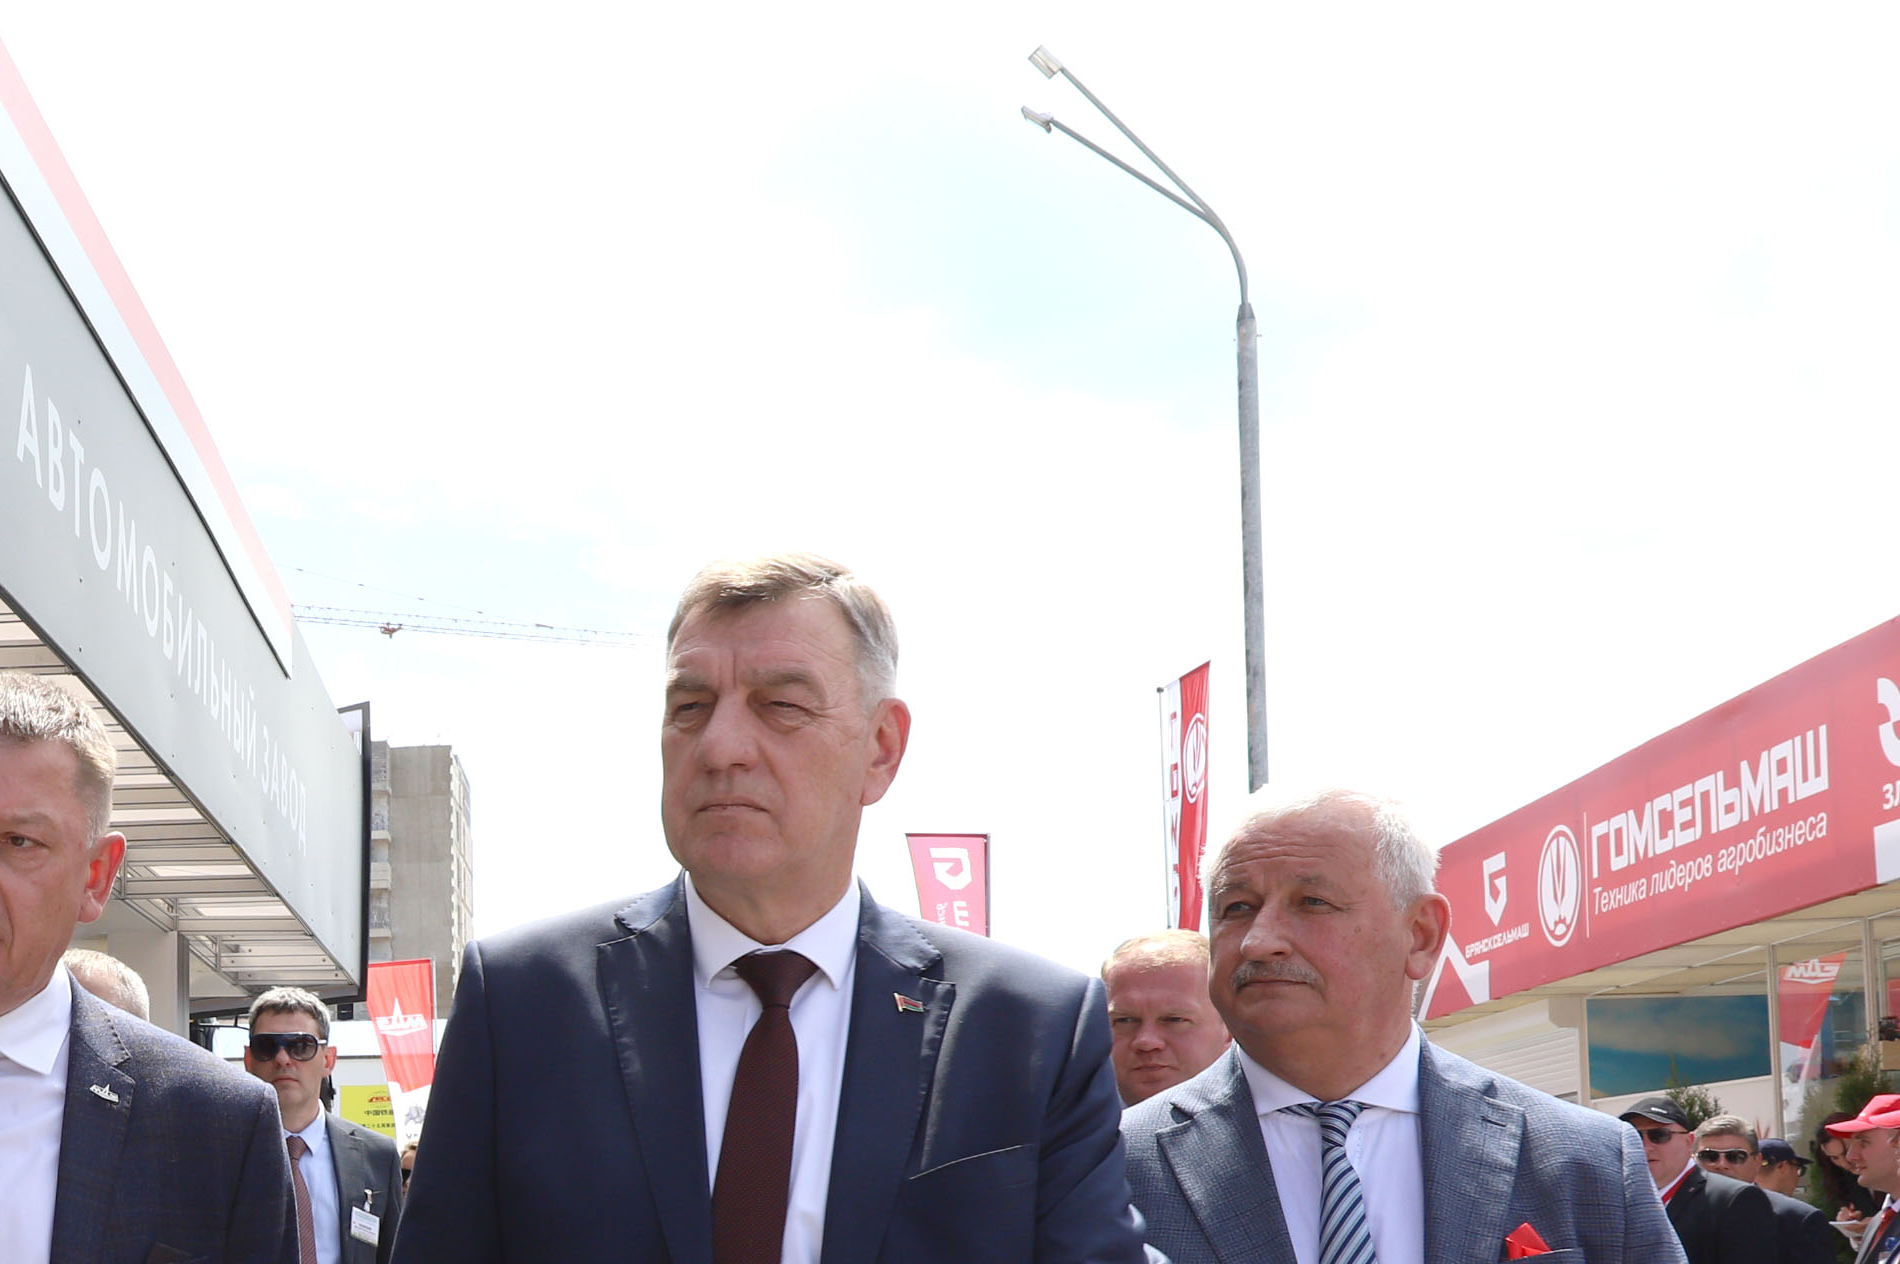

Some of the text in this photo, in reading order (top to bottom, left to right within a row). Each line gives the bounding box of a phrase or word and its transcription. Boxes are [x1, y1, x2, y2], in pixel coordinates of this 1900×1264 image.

[16, 363, 257, 777] АВТОМОБИЛЬНЫЙ
[261, 725, 307, 857] ЗАВОД
[1591, 724, 1829, 879] ГОМСЕЛЬМАШ
[1592, 811, 1828, 915] Техника лидеров агробизнеса
[1465, 922, 1530, 959] БРЯНСКСЕЛЬМАШ
